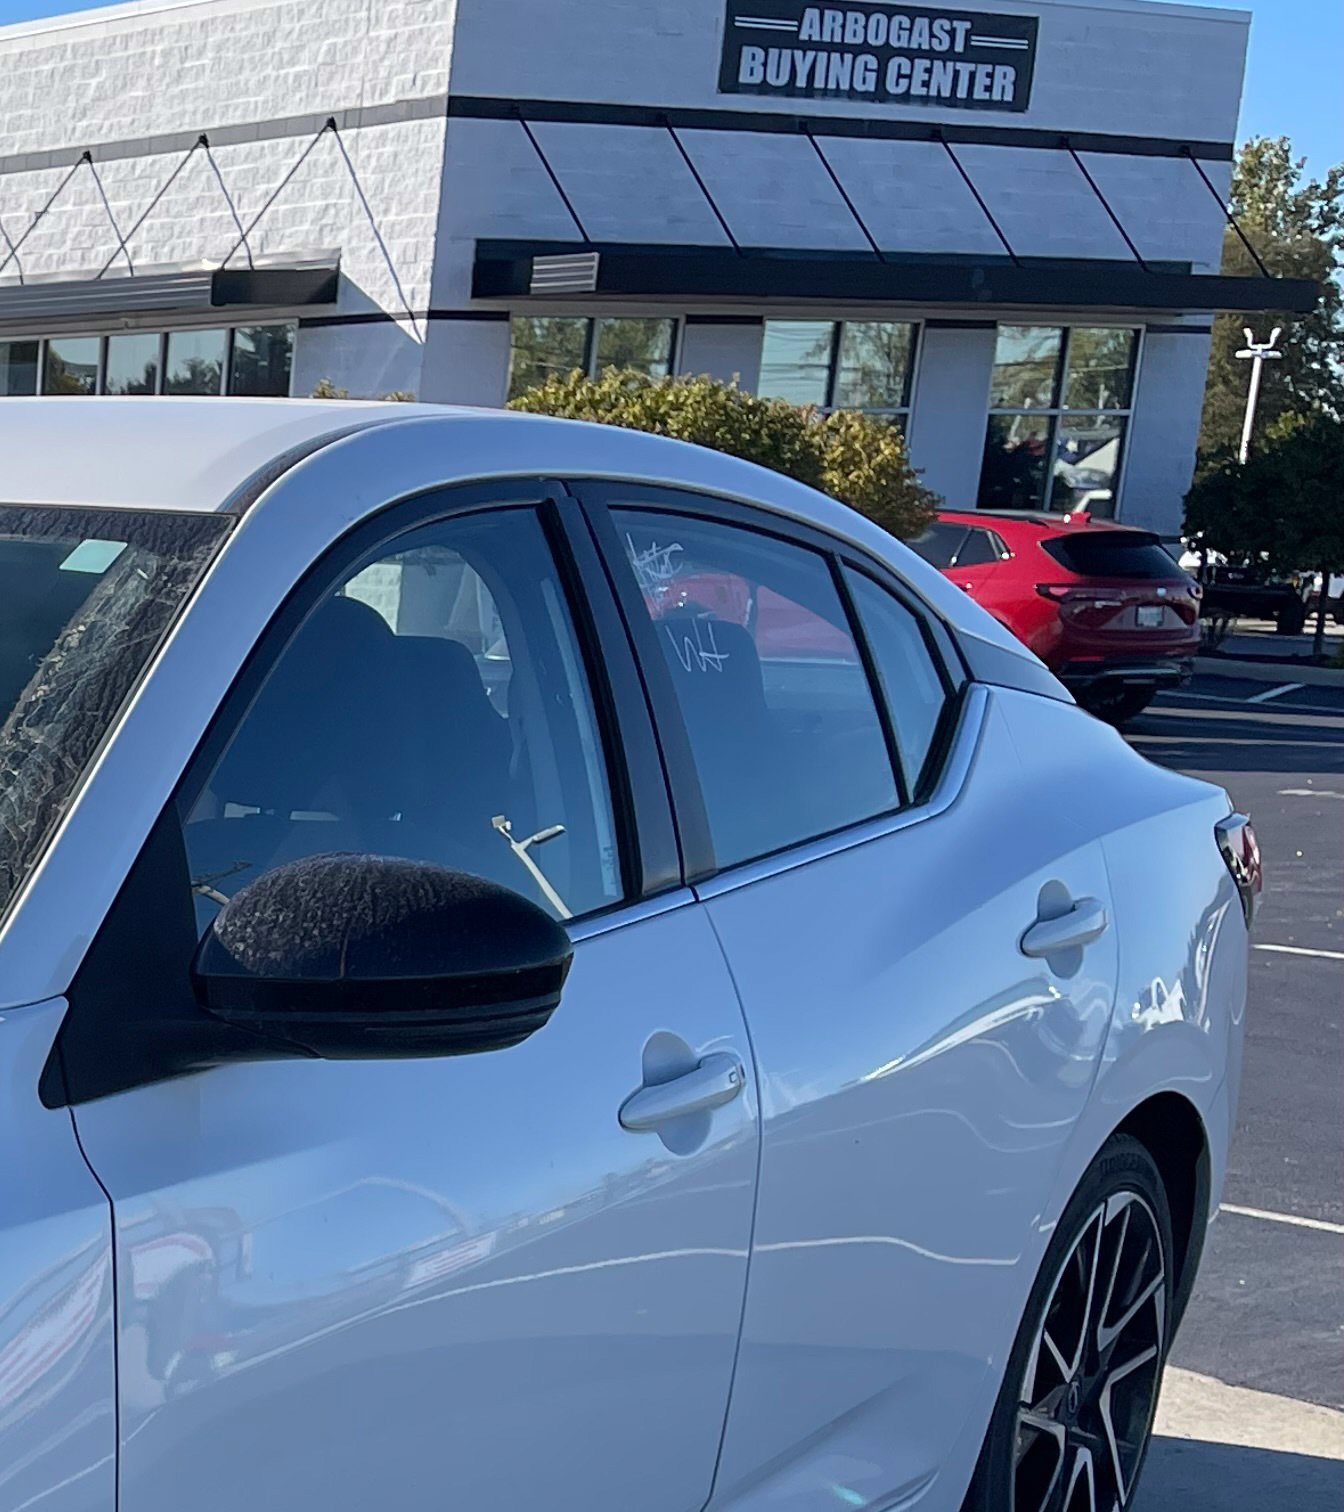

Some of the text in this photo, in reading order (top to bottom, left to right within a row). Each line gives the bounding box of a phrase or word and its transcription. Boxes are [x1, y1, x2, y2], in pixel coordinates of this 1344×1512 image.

[798, 8, 972, 53] ARBOGAST
[738, 46, 1016, 102] BUYING CENTER
